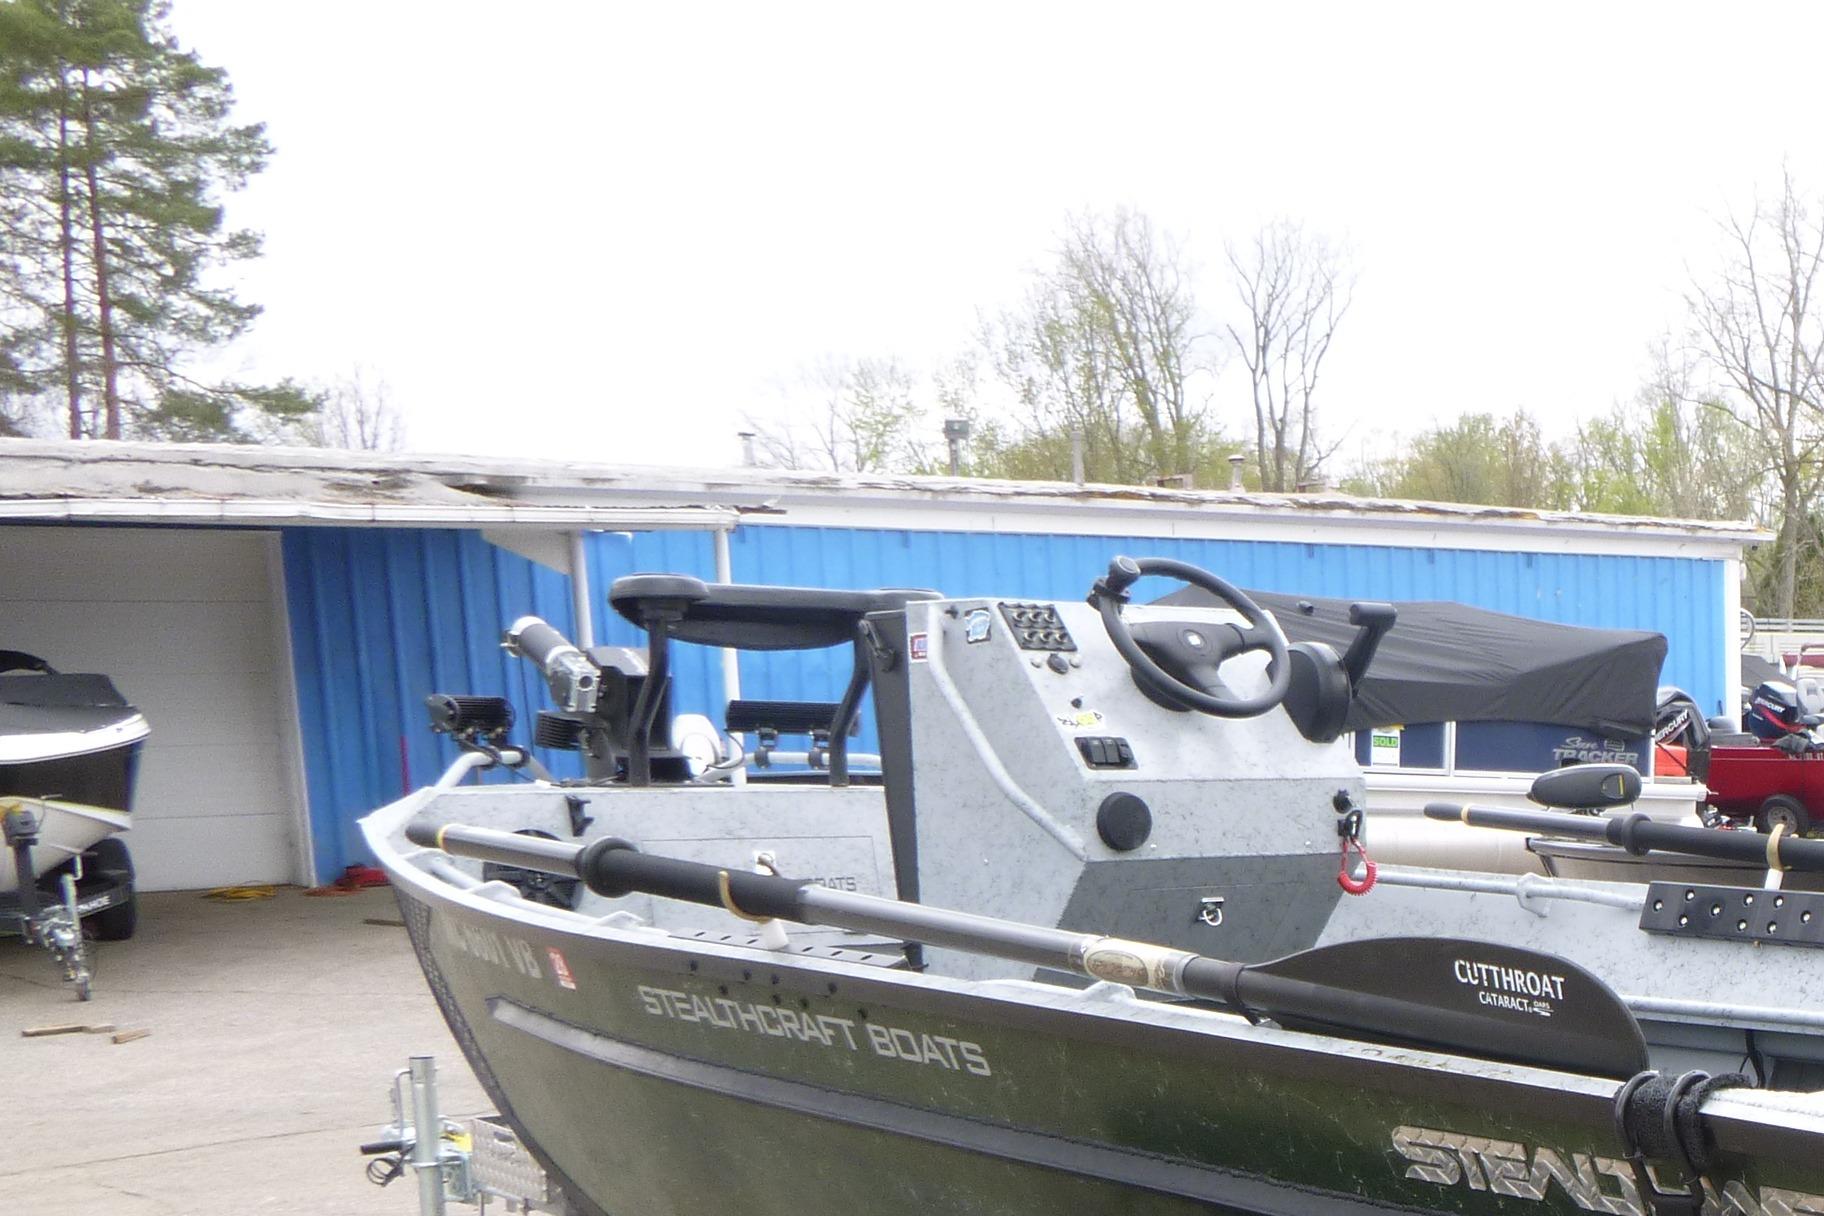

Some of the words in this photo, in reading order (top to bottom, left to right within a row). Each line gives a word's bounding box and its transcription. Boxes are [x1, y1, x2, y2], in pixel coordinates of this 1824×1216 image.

[1654, 708, 1689, 742] ERCURY
[1373, 736, 1398, 748] SOLD
[1553, 748, 1638, 765] TRACKER
[802, 876, 857, 892] OATS
[1454, 959, 1565, 1000] CUTTHROAT
[1479, 991, 1530, 1011] CATARACT
[637, 985, 858, 1050] STEALTHCRAFT
[866, 1023, 991, 1076] BOATS
